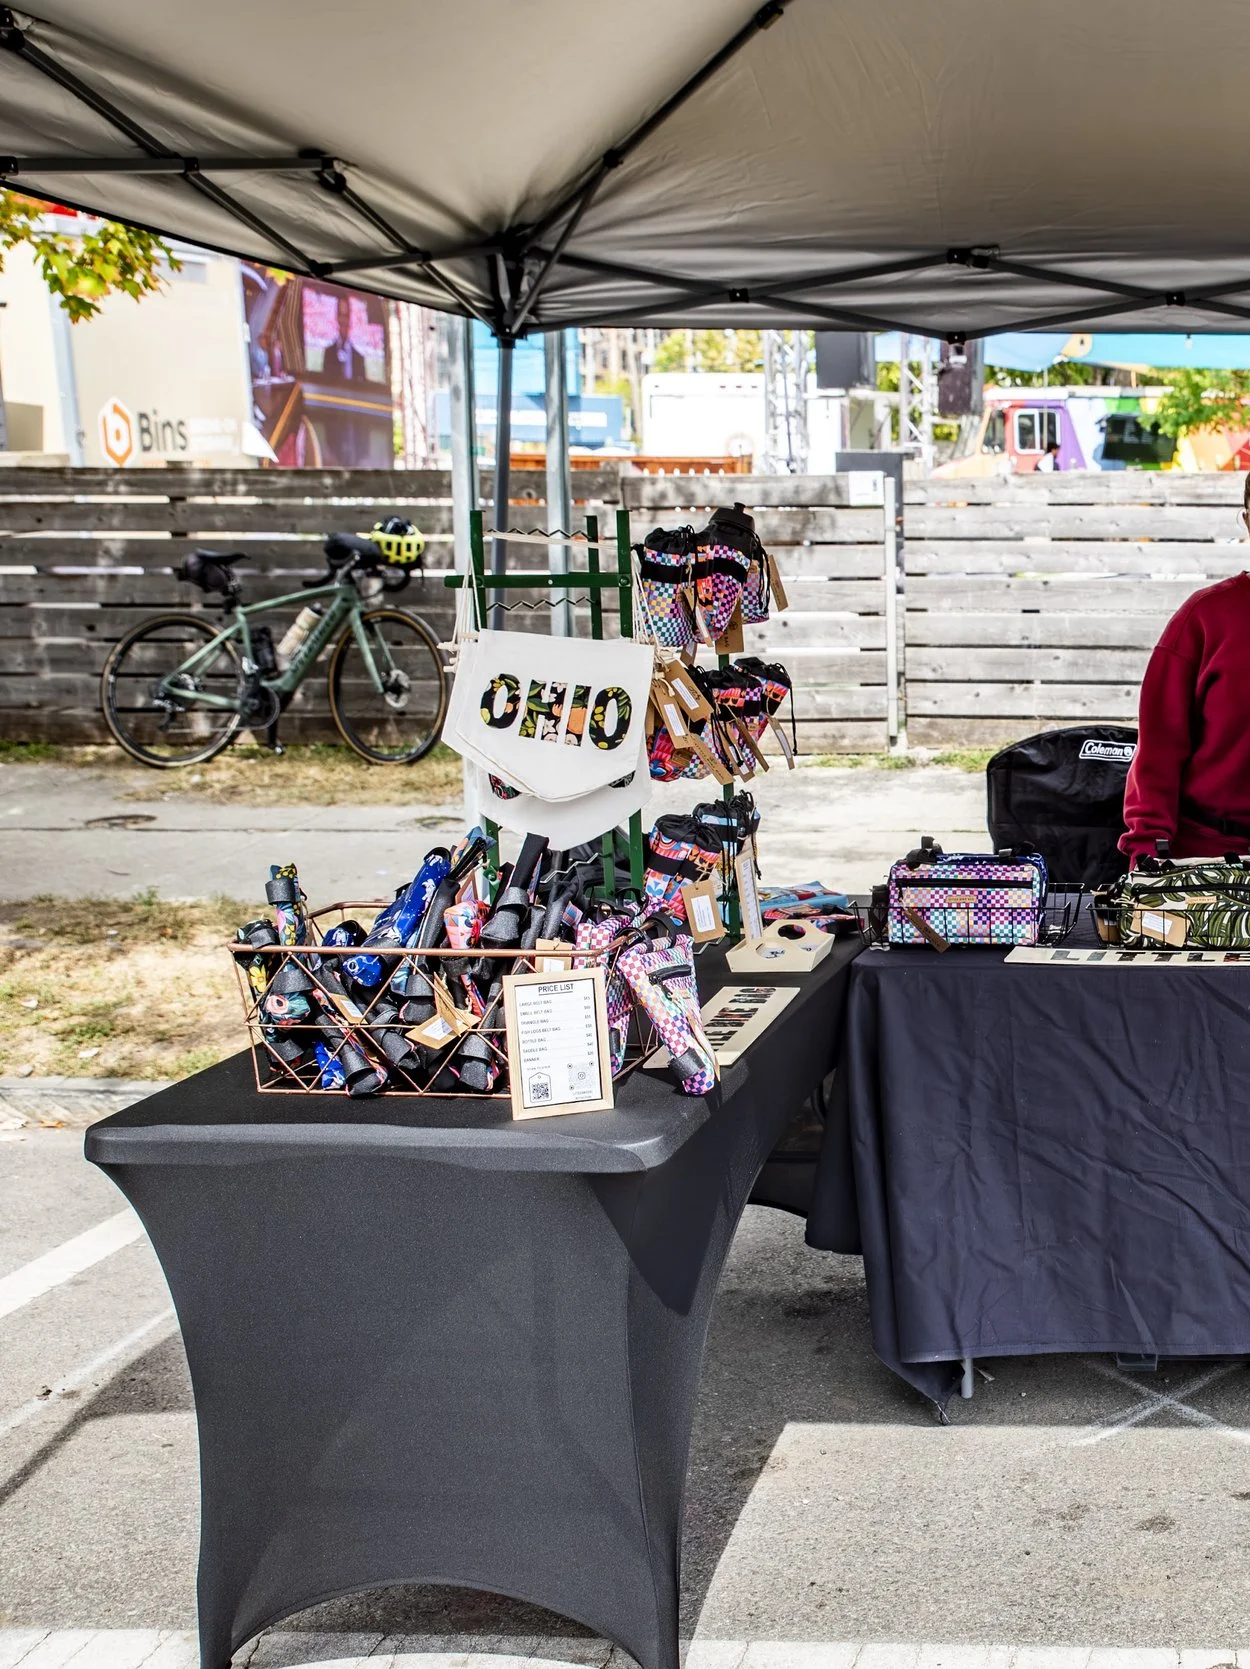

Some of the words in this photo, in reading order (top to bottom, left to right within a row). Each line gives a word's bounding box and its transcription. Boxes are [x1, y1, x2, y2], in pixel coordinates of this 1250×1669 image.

[138, 409, 188, 452] Bins
[480, 673, 632, 750] OHIO
[1085, 742, 1123, 756] Coleman
[538, 985, 559, 993] PRICE
[560, 983, 574, 991] LIST
